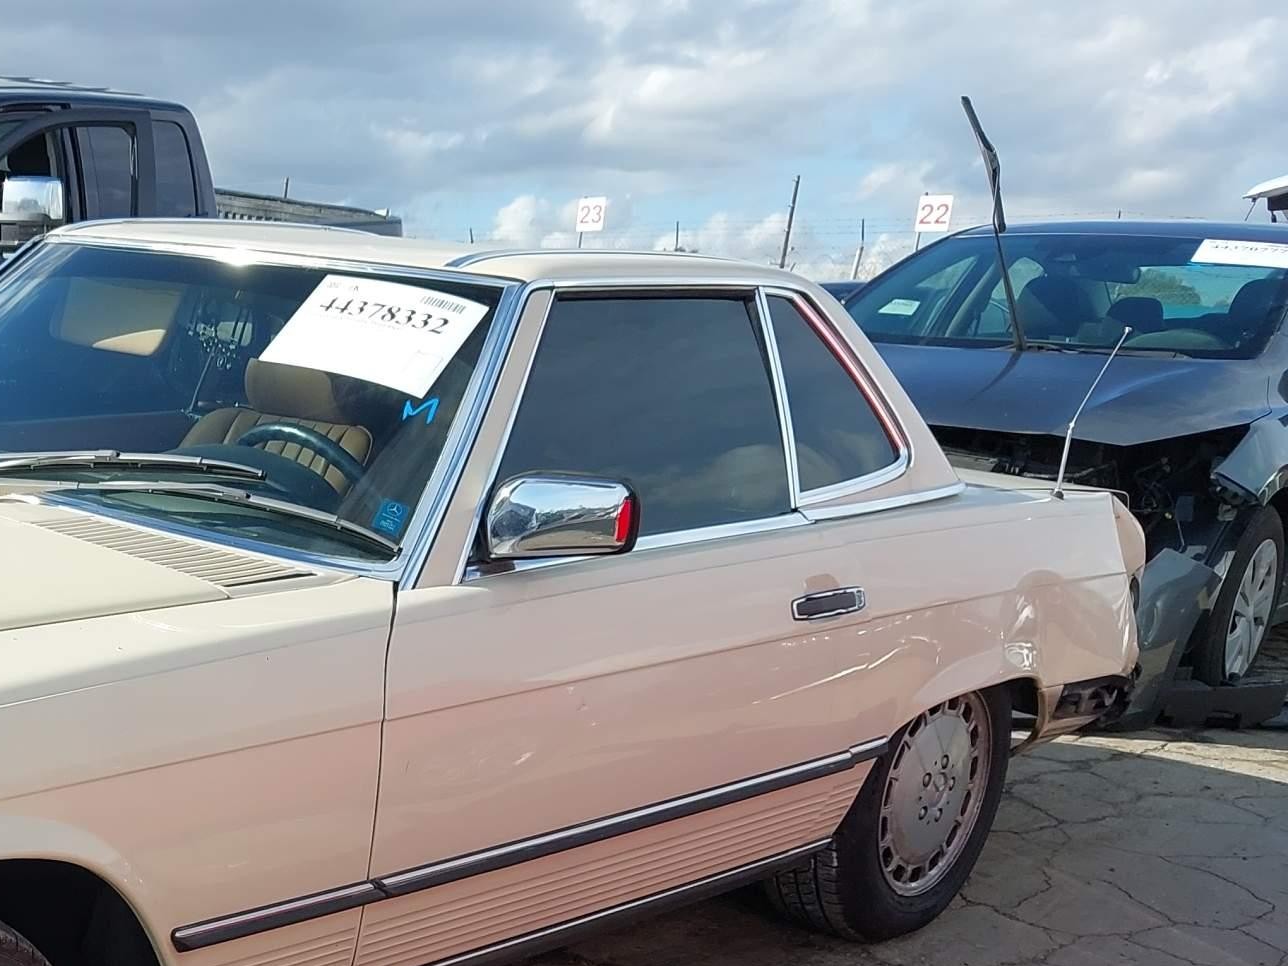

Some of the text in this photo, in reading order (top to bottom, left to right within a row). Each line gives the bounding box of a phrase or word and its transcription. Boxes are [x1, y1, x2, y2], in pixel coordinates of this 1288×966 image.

[580, 204, 603, 224] 23
[918, 203, 950, 225] 22
[319, 296, 450, 335] 44378332
[401, 397, 440, 425] M
